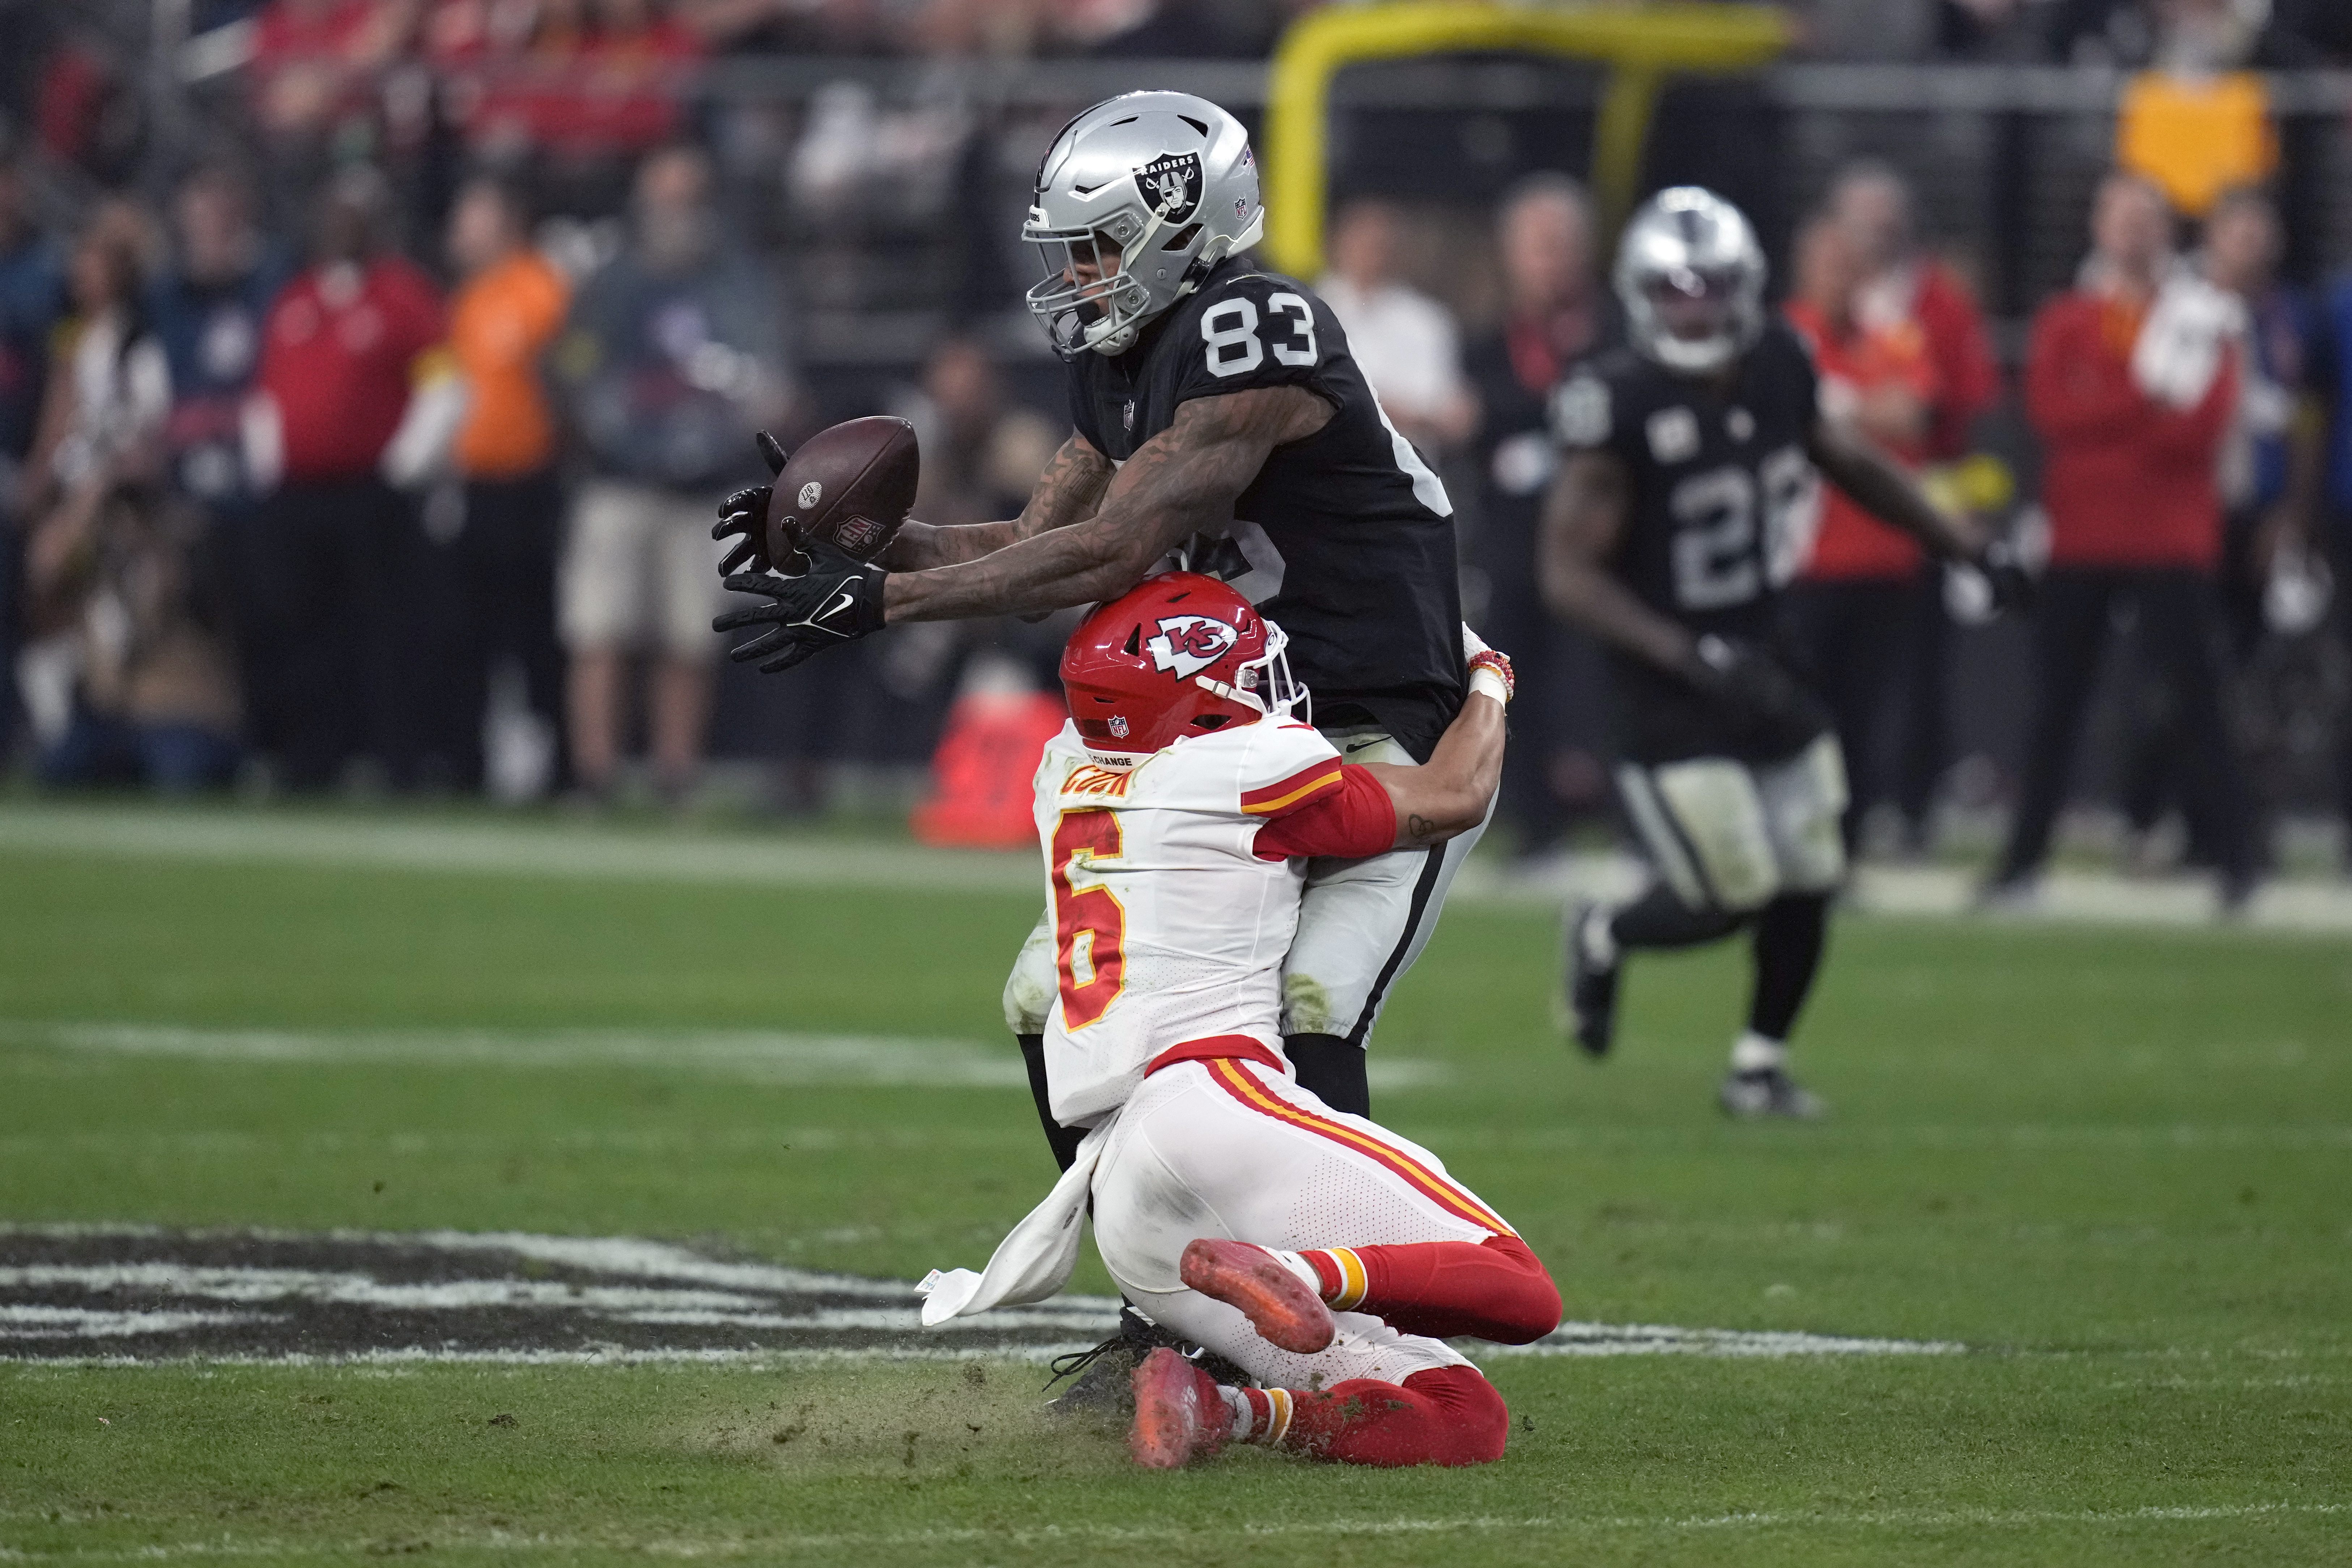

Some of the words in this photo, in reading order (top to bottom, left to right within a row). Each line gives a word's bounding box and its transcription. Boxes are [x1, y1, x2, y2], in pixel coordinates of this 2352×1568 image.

[1140, 156, 1193, 175] RAIDERS
[1237, 206, 1246, 217] NFL
[1201, 292, 1318, 378] 83
[837, 518, 870, 545] NFL
[1165, 620, 1228, 658] KC
[1113, 725, 1127, 735] NFL
[1093, 756, 1132, 766] CHANGE
[1051, 807, 1126, 1033] 6
